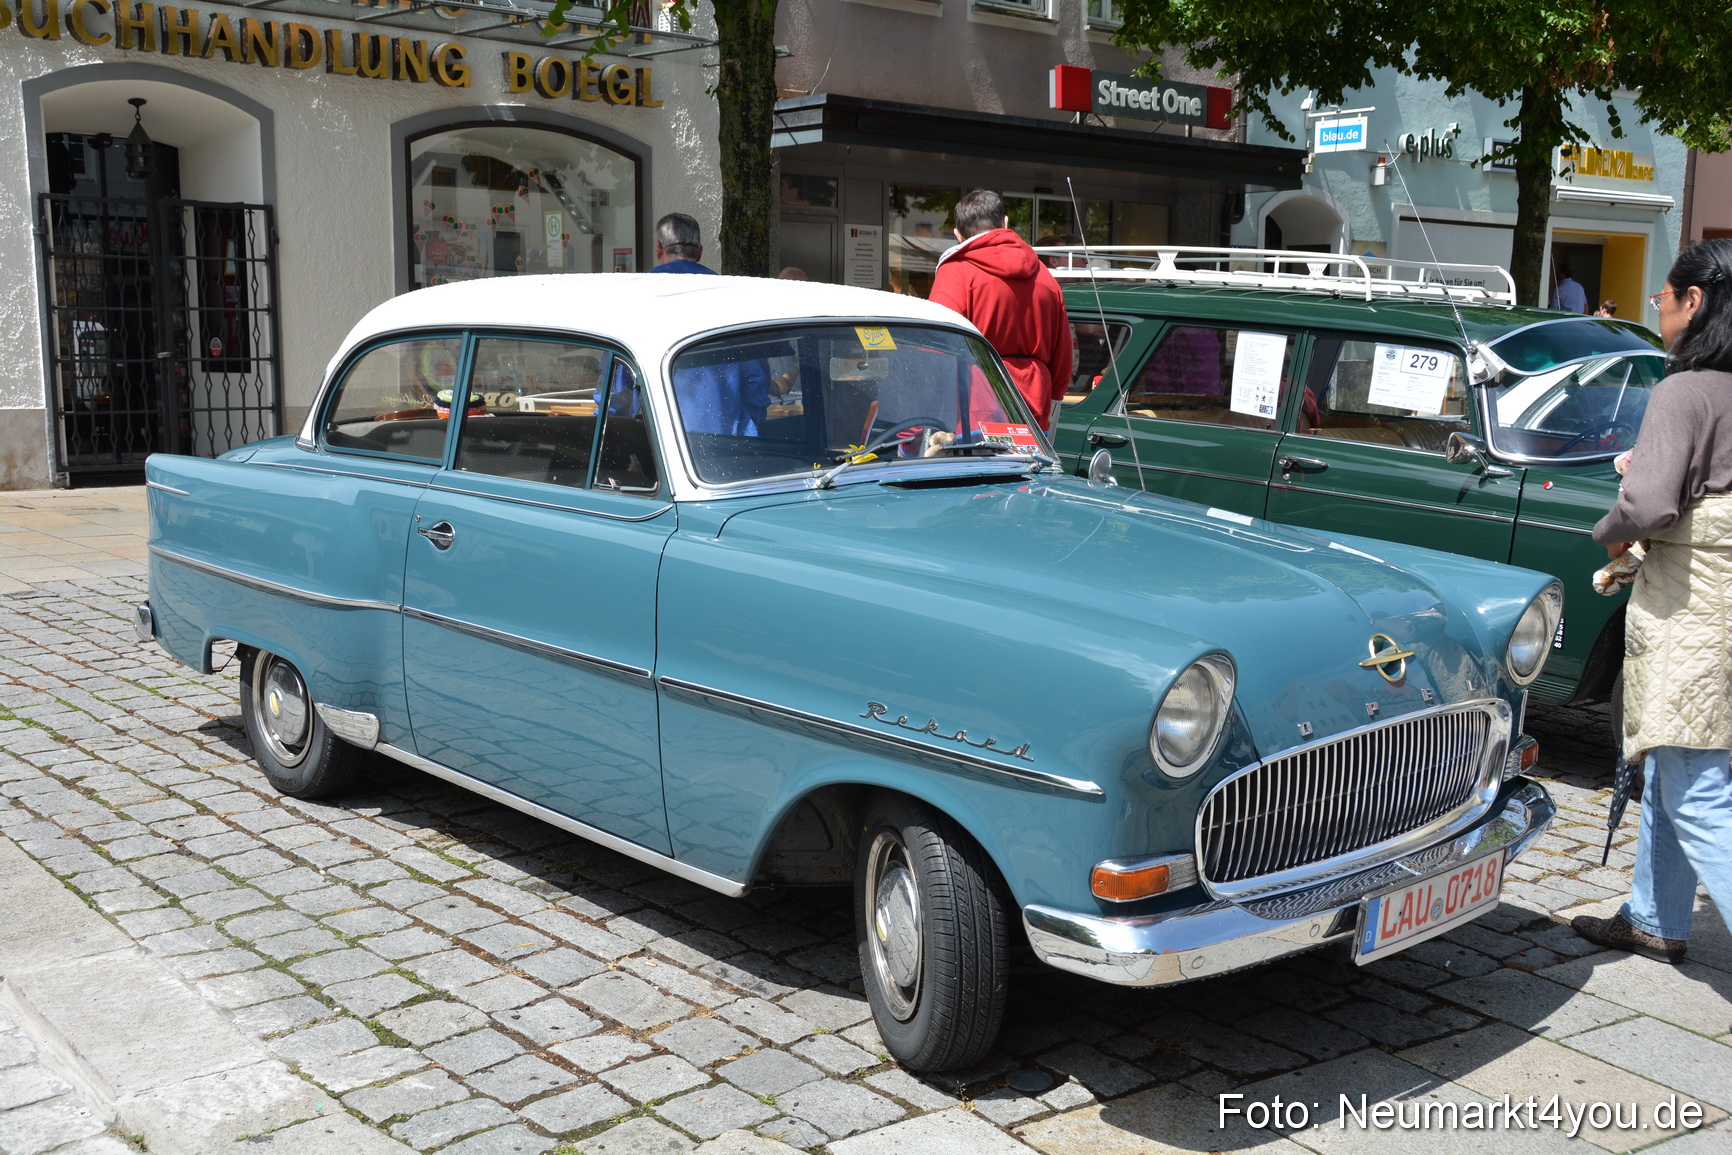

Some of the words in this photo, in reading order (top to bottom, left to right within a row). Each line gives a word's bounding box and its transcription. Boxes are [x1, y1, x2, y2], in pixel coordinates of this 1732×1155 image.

[502, 51, 664, 107] BOEGL
[1099, 79, 1160, 112] Street
[1163, 88, 1201, 117] One
[1322, 129, 1359, 142] blau.de
[1409, 353, 1439, 371] 279
[859, 701, 1035, 762] Rekord
[1297, 679, 1476, 737] OPEL
[1365, 930, 1372, 943] D
[1380, 884, 1433, 941] LAU
[1445, 857, 1498, 915] 0718
